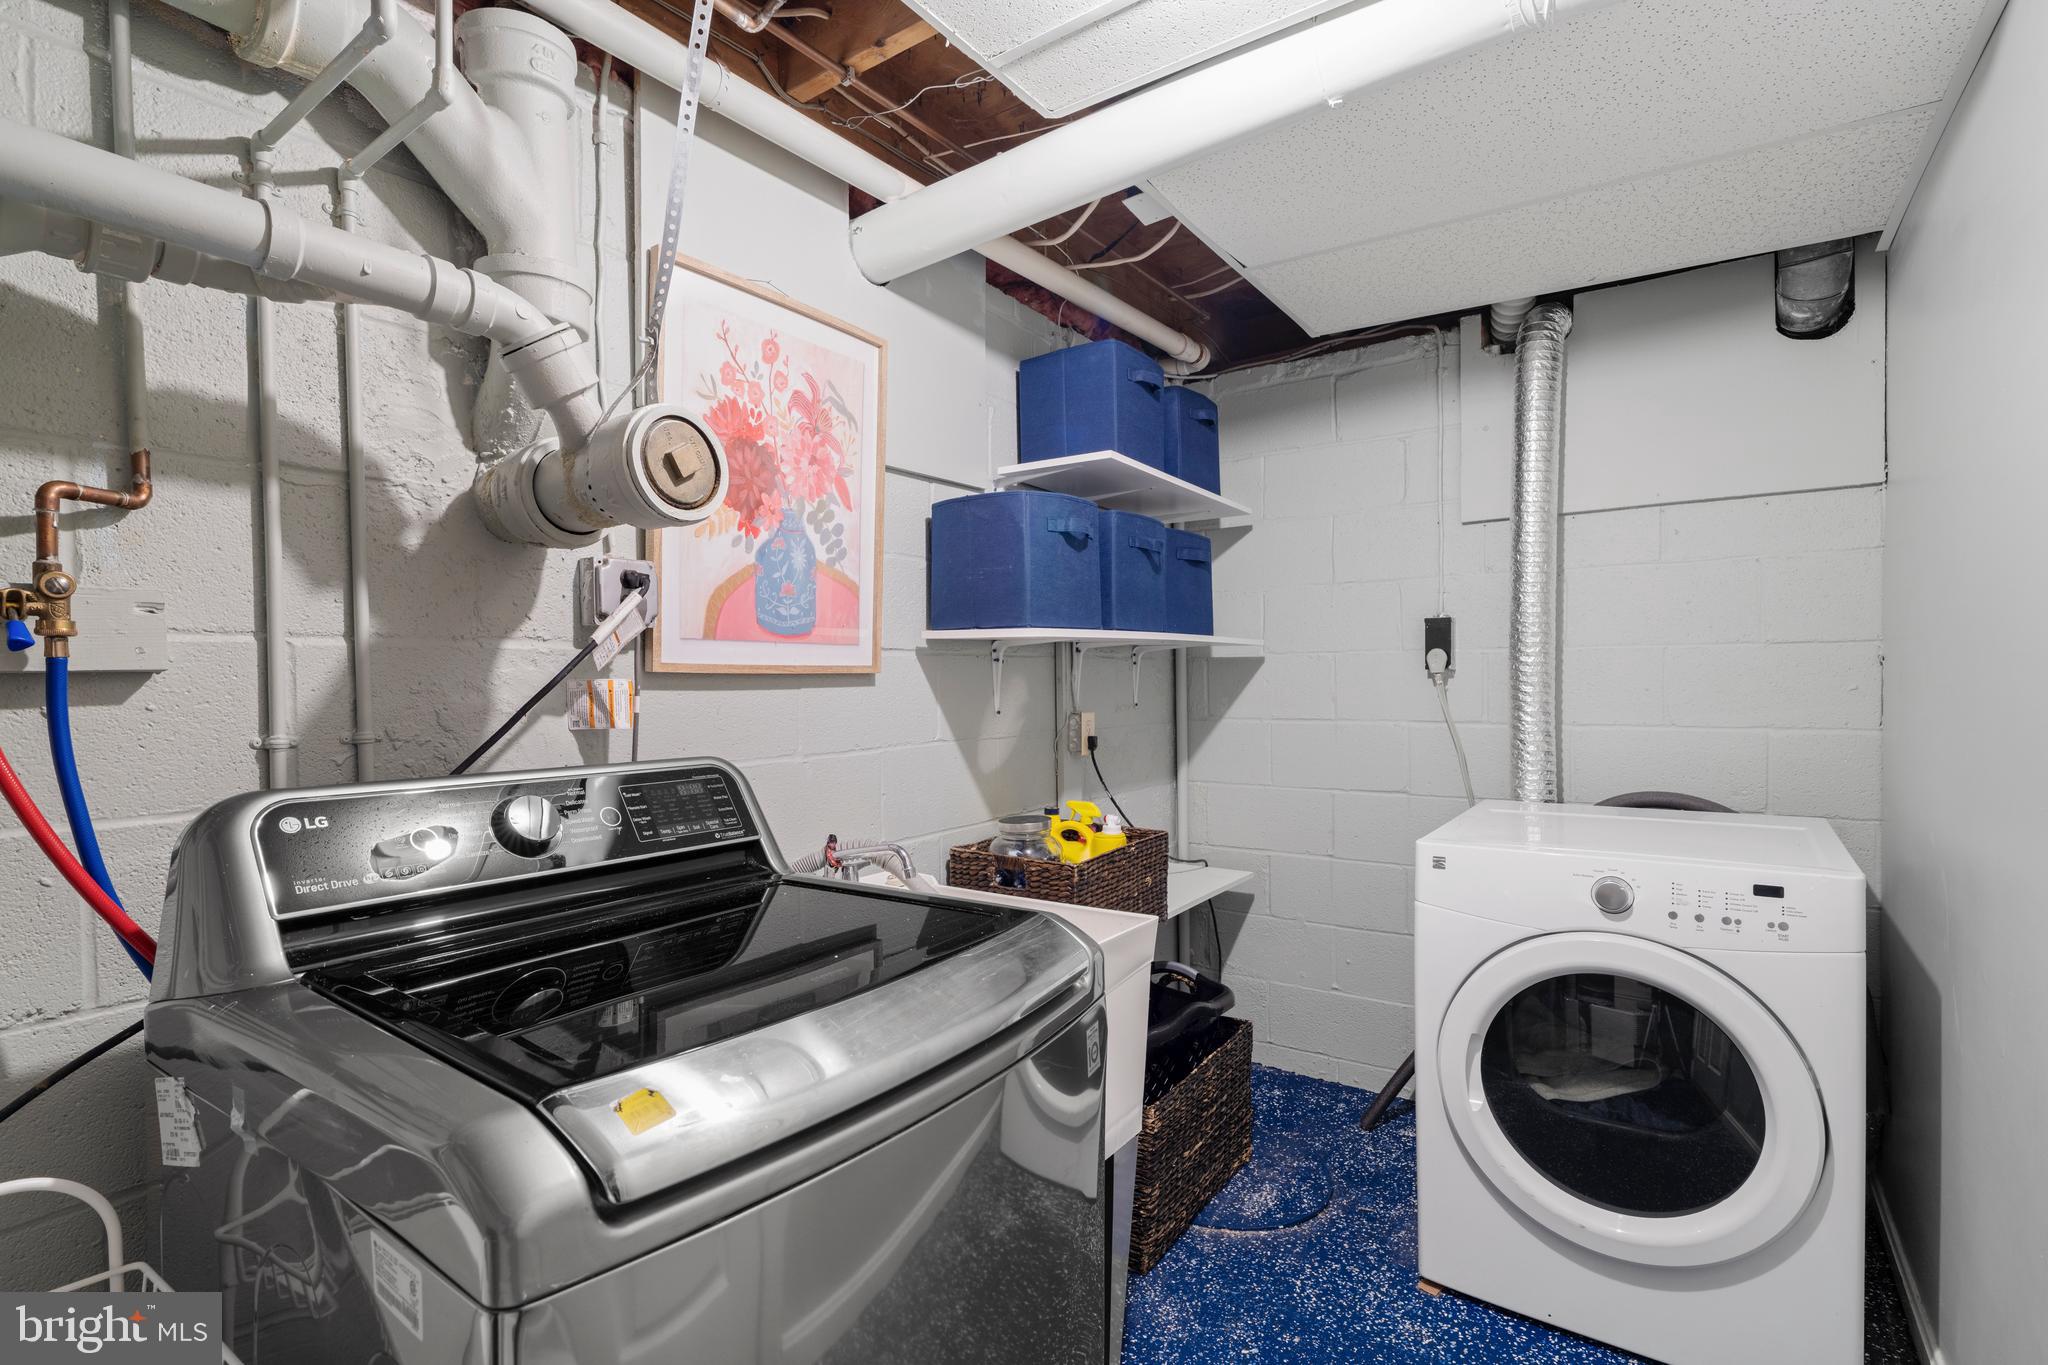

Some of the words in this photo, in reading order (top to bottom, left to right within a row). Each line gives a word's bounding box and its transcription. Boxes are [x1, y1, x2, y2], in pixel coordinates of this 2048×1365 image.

[304, 816, 329, 829] LG
[295, 883, 329, 895] Direct
[331, 878, 359, 890] Drive
